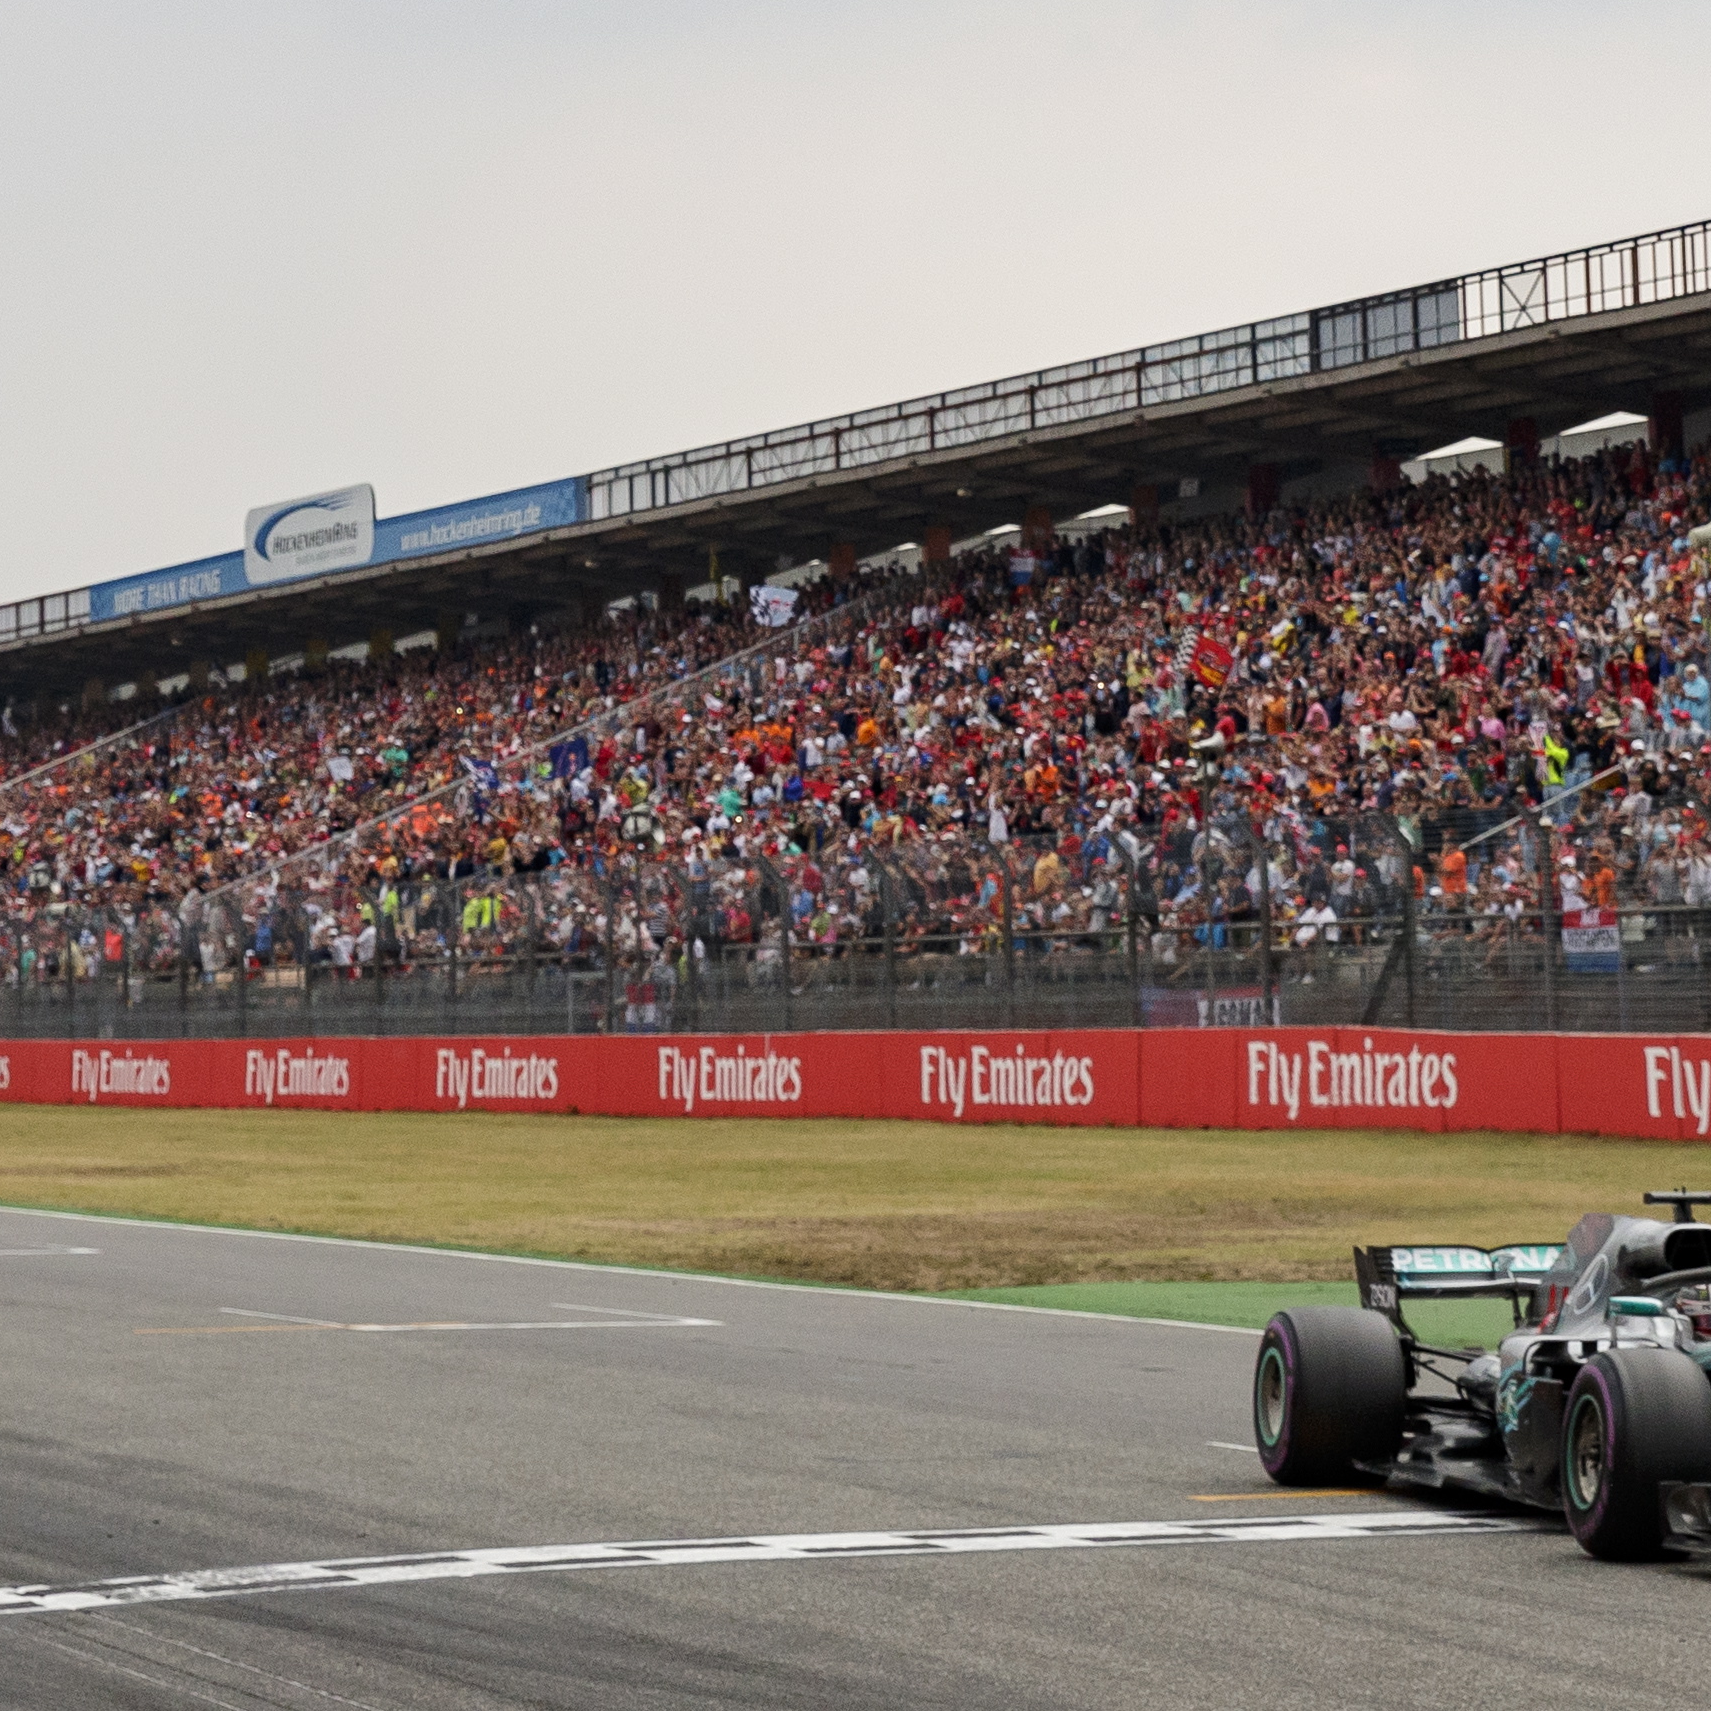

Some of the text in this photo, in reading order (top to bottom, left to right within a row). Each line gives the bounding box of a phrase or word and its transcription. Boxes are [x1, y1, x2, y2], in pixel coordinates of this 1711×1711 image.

[71, 1047, 170, 1101] Fly Emirates
[246, 1047, 350, 1105] Fly Emirates
[436, 1046, 558, 1109] Fly Emirates
[658, 1044, 802, 1112] Fly Emirates
[920, 1043, 1094, 1118] Fly Emirates
[1247, 1036, 1459, 1120] Fly Emirates
[1643, 1045, 1711, 1136] Fly
